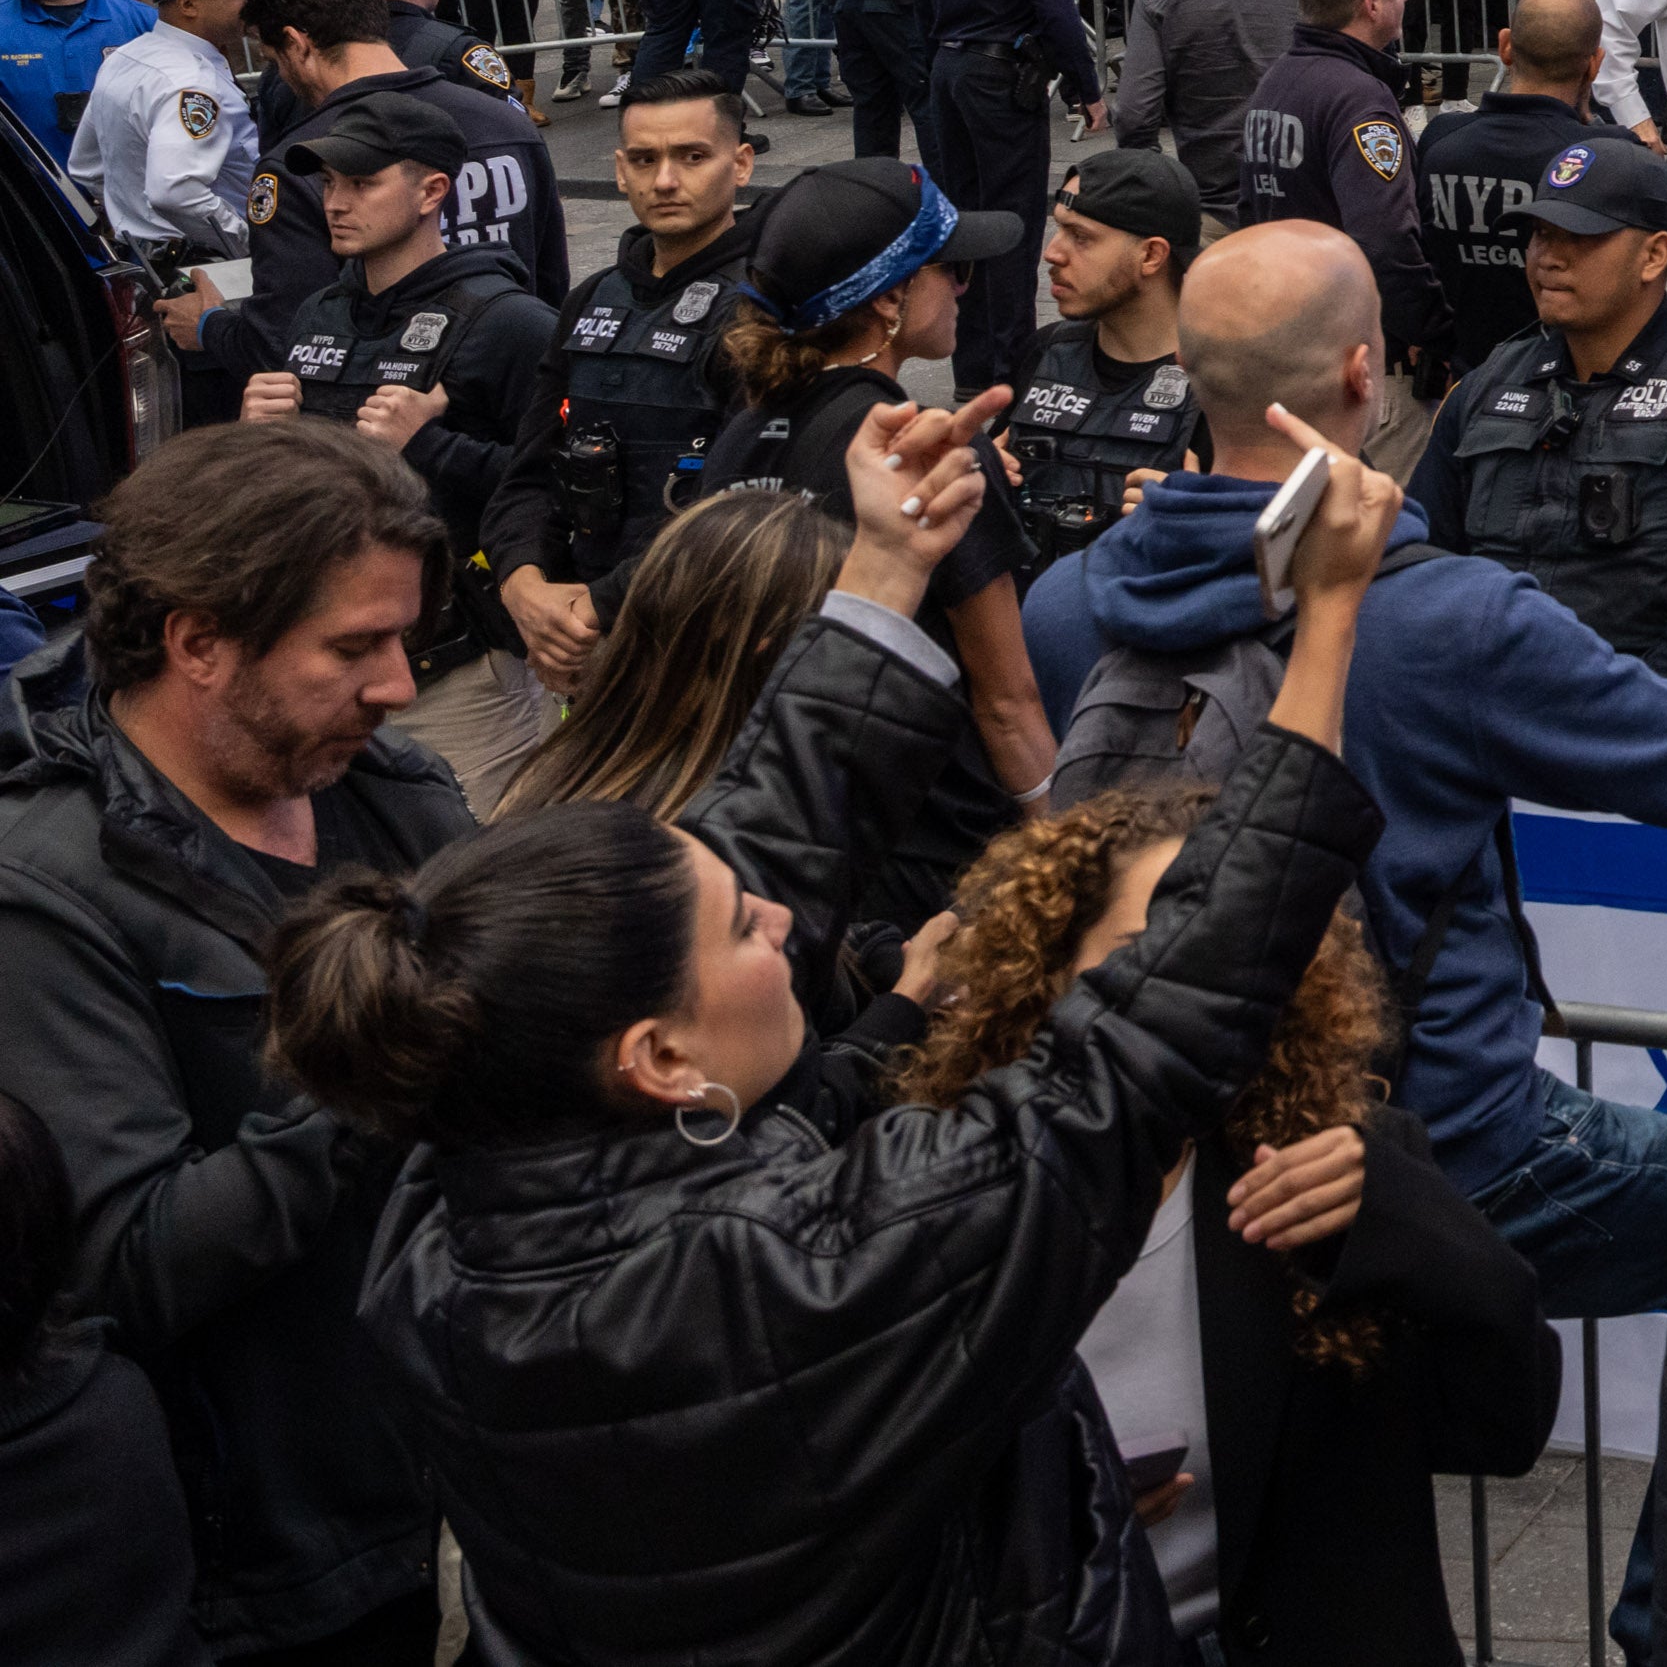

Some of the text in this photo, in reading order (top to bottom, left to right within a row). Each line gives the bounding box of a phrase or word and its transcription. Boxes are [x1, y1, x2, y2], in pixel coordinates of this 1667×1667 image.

[594, 306, 612, 318] NYPD
[574, 318, 621, 338] POLICE
[312, 334, 335, 346] NYPD
[288, 344, 347, 368] POLICE
[300, 364, 319, 376] CRT
[378, 360, 420, 374] MAHONEY
[1050, 382, 1074, 396] NYPD
[1024, 386, 1090, 418] POLICE
[1502, 392, 1530, 404] AUNG
[1494, 400, 1526, 414] 22465
[1034, 407, 1062, 424] CRT
[1129, 412, 1161, 427] RIVERA
